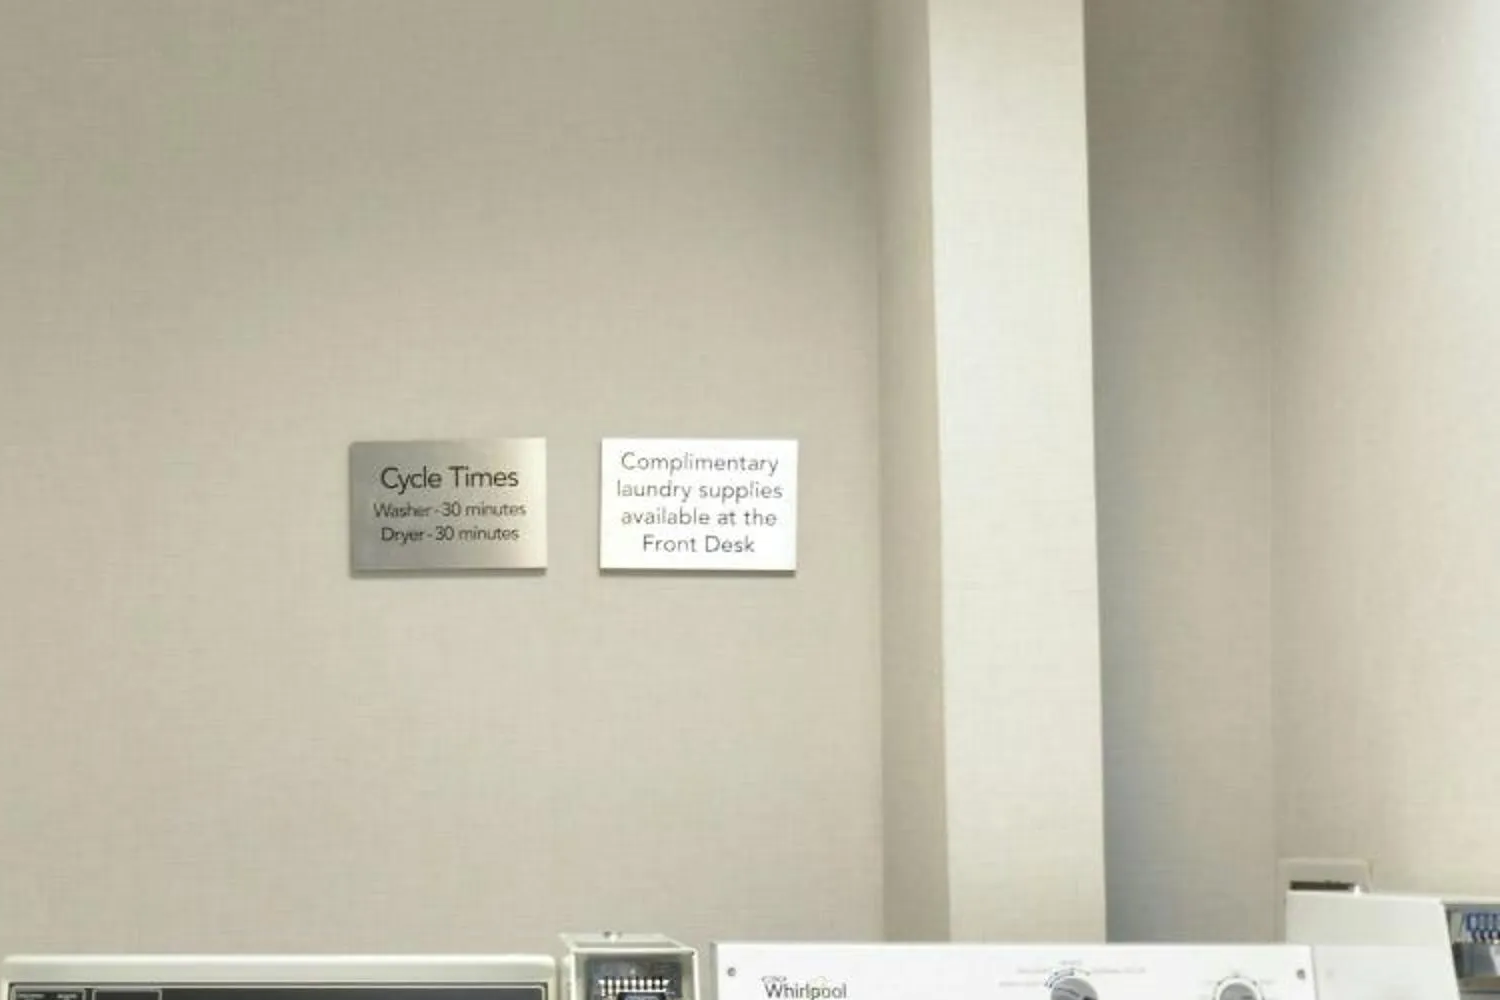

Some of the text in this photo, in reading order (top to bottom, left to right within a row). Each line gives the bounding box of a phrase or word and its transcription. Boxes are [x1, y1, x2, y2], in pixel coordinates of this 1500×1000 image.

[620, 451, 779, 477] Complimentary
[380, 465, 520, 495] Cycle Times
[616, 480, 784, 505] laundry supplies
[373, 502, 432, 518] Washer
[441, 502, 462, 517] 30
[465, 501, 528, 517] minutes
[620, 507, 778, 527] available at the
[380, 526, 424, 545] Dryer
[435, 526, 454, 541] 30
[458, 525, 520, 541] minutes
[643, 533, 756, 553] Front Desk
